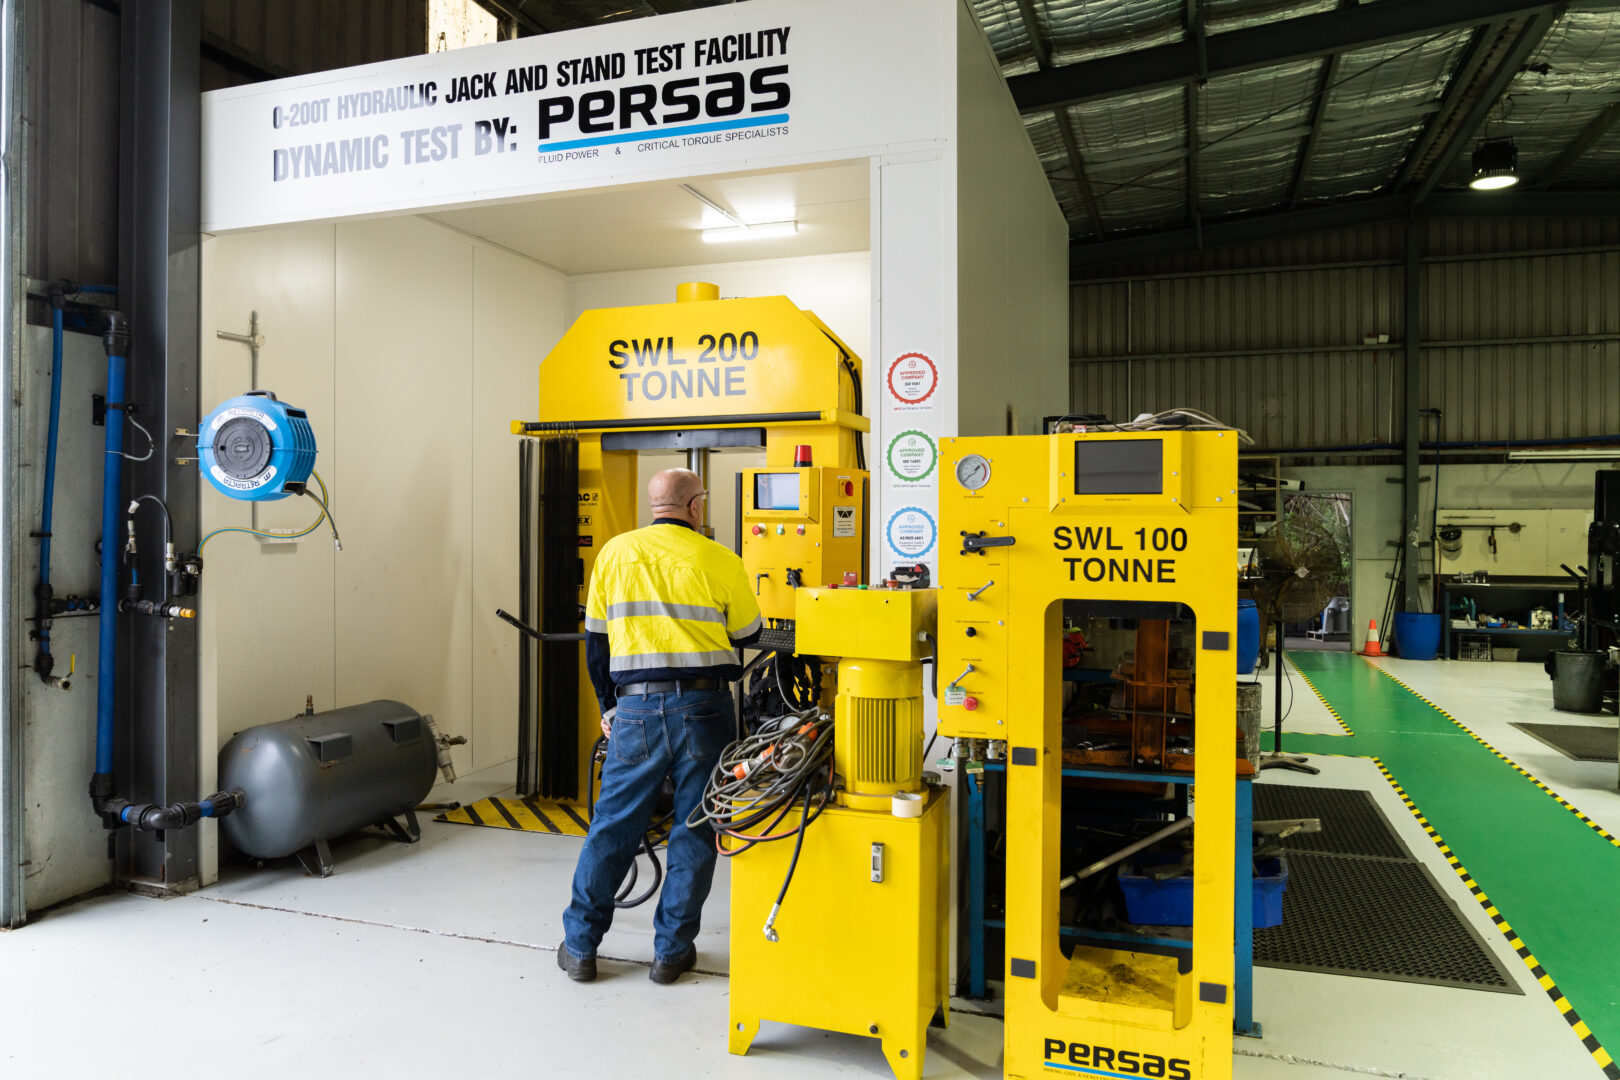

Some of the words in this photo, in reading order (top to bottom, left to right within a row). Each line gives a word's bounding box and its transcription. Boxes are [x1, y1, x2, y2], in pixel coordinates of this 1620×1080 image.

[273, 98, 330, 129] 0-200T
[337, 81, 437, 120] HYDRAULIC
[445, 72, 497, 104] JACK
[505, 64, 548, 95] AND
[557, 52, 625, 87] STAND
[634, 43, 685, 75] TEST
[695, 26, 791, 67] FACILITY
[273, 134, 389, 182] DYNAMIC
[400, 123, 462, 165] TEST
[475, 117, 517, 156] BY:
[538, 154, 563, 165] FLUID
[565, 149, 599, 161] POWER
[614, 146, 621, 155] &
[637, 139, 680, 152] CRITICAL
[682, 133, 722, 148] TORQUE
[725, 126, 789, 142] SPECIALISTS
[608, 336, 686, 370] SWL
[698, 331, 759, 363] 200
[620, 366, 747, 402] TONNE
[1053, 526, 1123, 551] SWL
[1135, 527, 1188, 552] 100
[1063, 557, 1176, 583] TONNE
